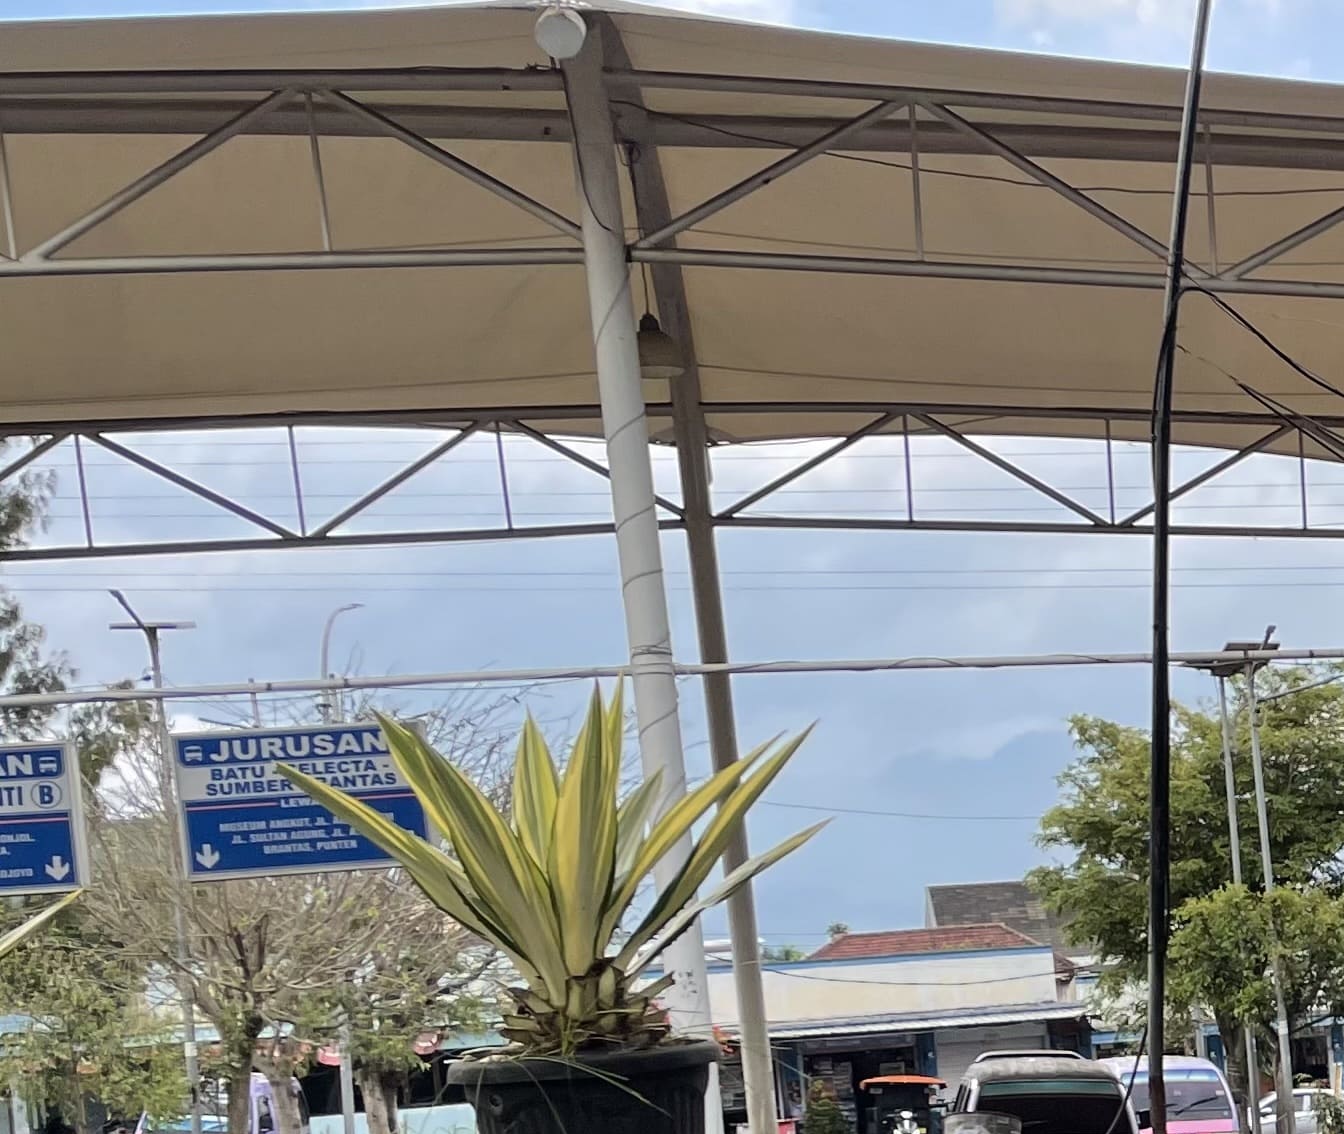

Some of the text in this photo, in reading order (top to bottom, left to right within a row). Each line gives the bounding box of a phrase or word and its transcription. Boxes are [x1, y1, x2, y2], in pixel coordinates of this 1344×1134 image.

[210, 732, 388, 762] JURUSAN
[210, 765, 265, 781] BATU
[39, 785, 54, 804] B
[206, 779, 294, 797] SUMBER
